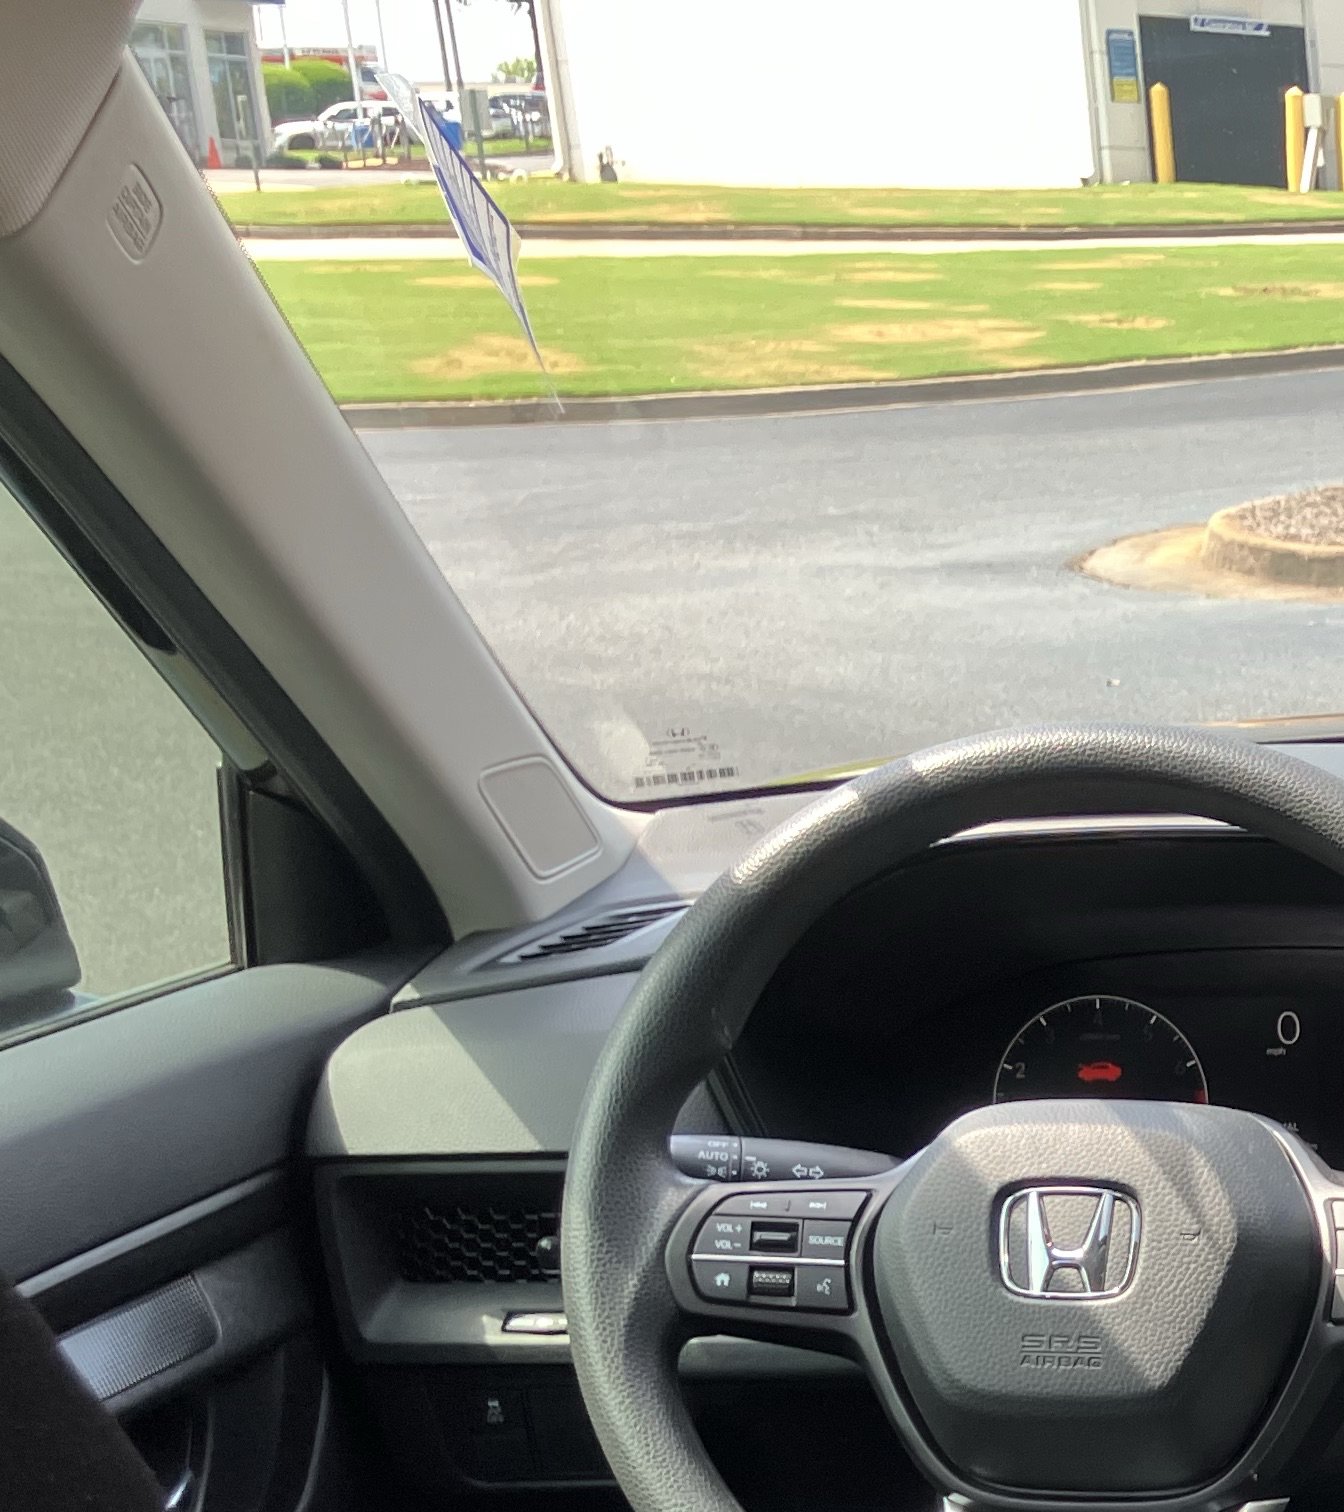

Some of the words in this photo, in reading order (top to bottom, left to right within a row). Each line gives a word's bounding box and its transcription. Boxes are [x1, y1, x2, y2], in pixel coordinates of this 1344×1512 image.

[1277, 1010, 1301, 1045] 0
[1015, 1062, 1026, 1079] 2
[708, 1140, 729, 1148] OFF
[698, 1151, 729, 1162] AUTO
[716, 1222, 734, 1233] VOL
[714, 1239, 732, 1249] VOL
[808, 1235, 845, 1247] SOURCE
[1021, 1334, 1102, 1353] SRS
[1020, 1353, 1103, 1369] AIRBAG
